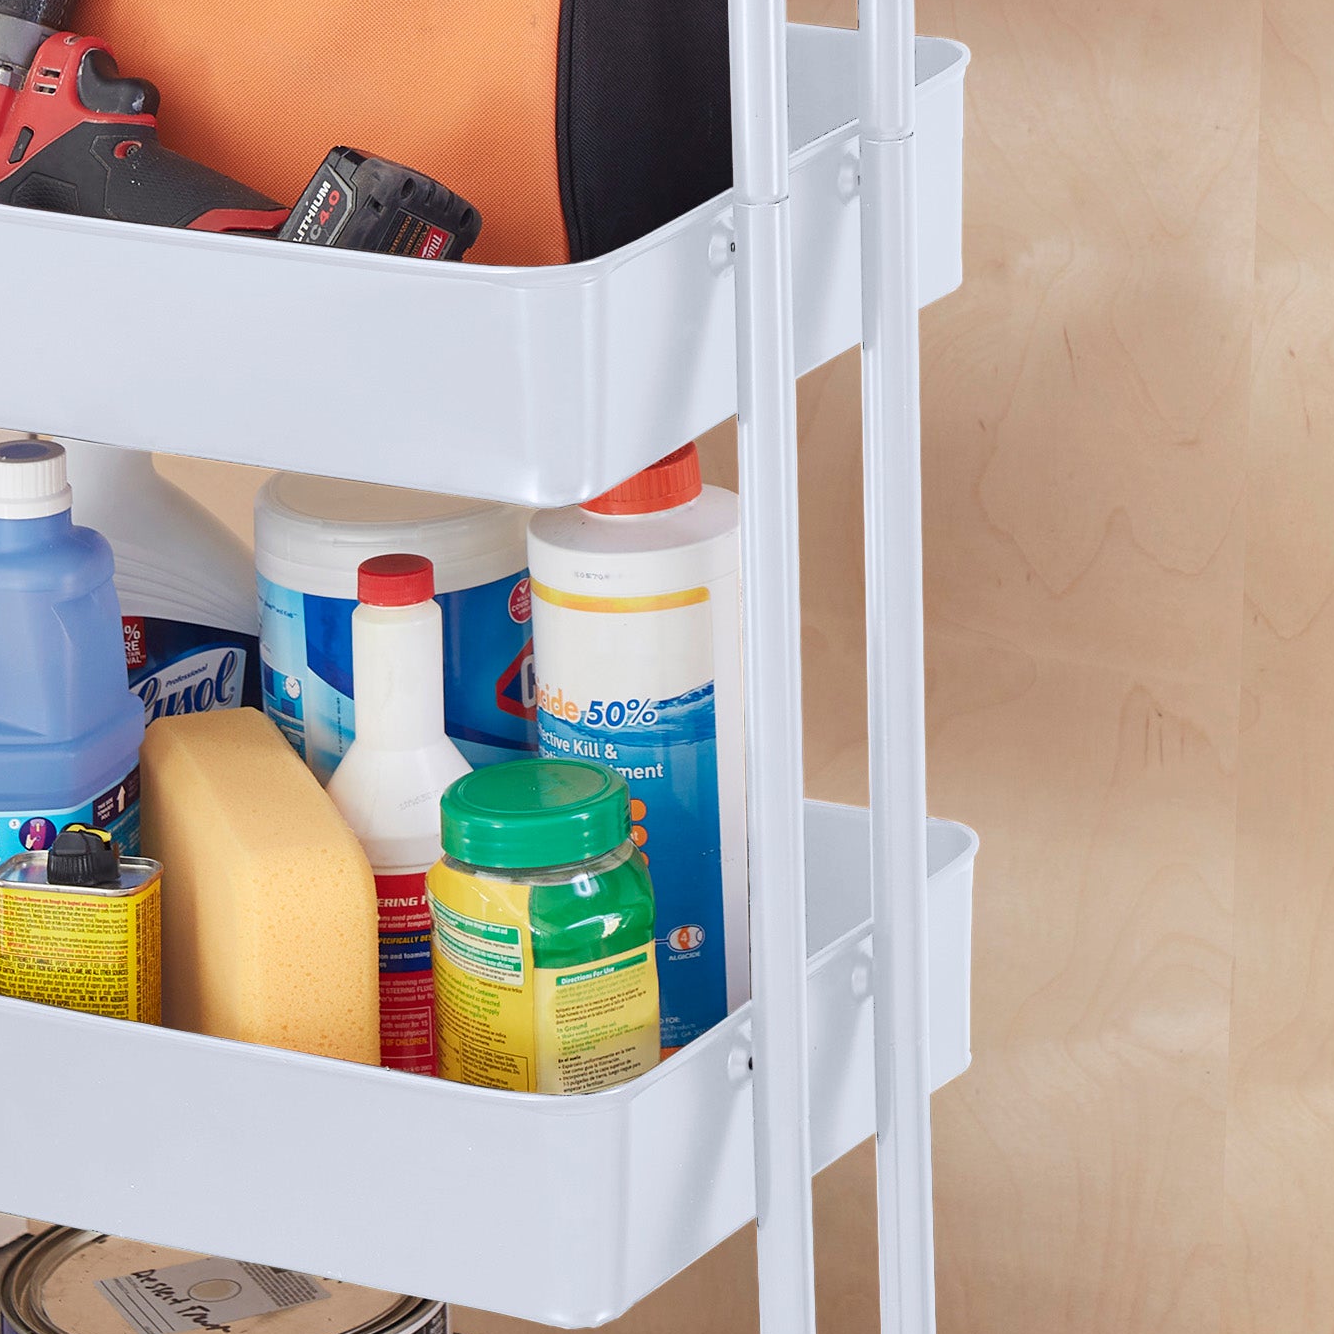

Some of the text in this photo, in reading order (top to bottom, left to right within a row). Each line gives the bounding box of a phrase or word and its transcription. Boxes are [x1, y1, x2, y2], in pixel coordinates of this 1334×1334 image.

[586, 698, 657, 727] 50%
[573, 740, 601, 759] Kill
[604, 744, 618, 760] &
[618, 763, 664, 780] ment
[560, 966, 615, 985] Directions For Use
